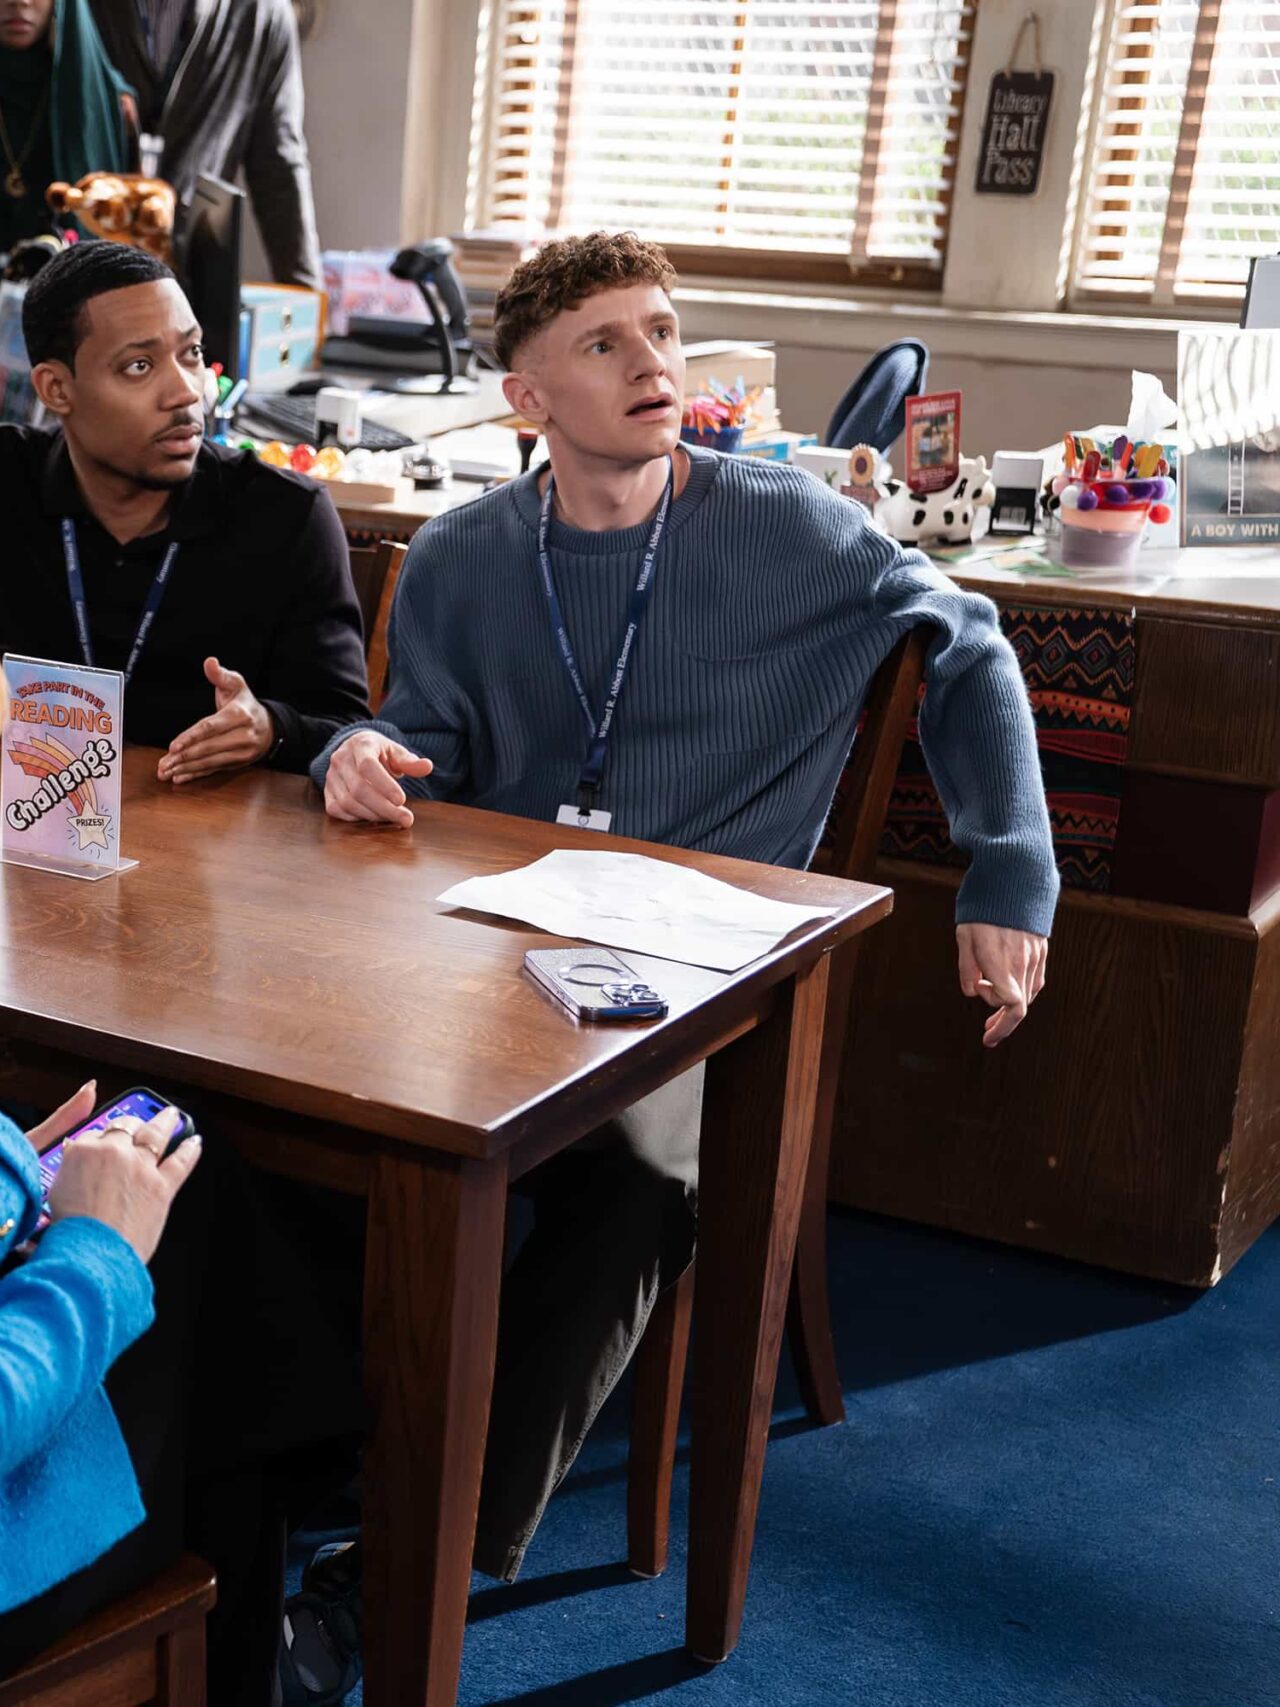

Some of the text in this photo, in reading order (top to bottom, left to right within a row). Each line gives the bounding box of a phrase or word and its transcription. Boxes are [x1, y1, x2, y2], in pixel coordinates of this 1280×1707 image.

[993, 88, 1047, 114] Library
[988, 114, 1040, 151] Hall
[982, 147, 1034, 185] Pass
[1191, 523, 1279, 537] A BOY WITH
[16, 681, 106, 711] TAKE PART IN THE
[10, 699, 113, 734] READING
[6, 739, 116, 831] Challenge
[75, 818, 105, 827] PRIZES!
